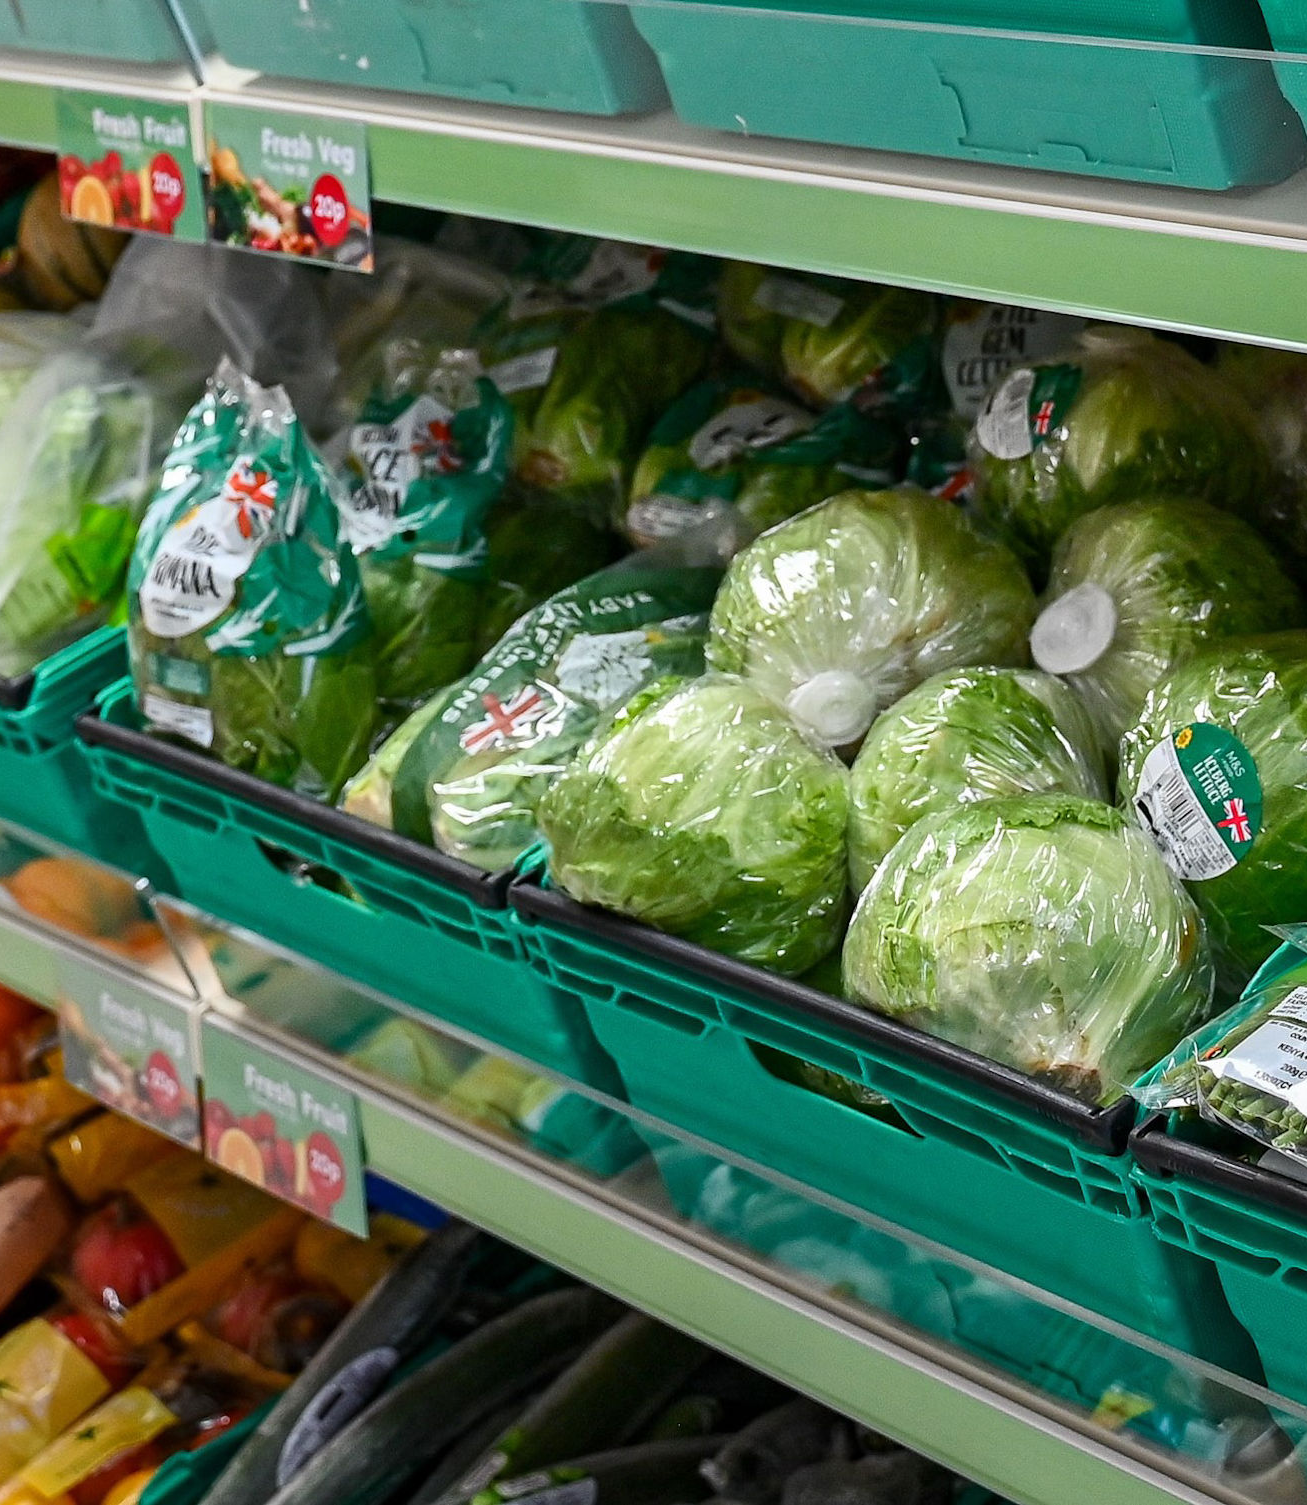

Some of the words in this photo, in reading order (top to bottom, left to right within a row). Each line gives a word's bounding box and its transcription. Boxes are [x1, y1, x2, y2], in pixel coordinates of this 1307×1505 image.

[93, 108, 140, 140] Fresh
[144, 116, 186, 147] Fruit
[261, 127, 312, 159] Fresh
[316, 136, 355, 174] Veg
[314, 194, 345, 223] 20p
[1193, 762, 1220, 805] LETTUCE
[1203, 755, 1233, 797] ICEBERG
[1226, 751, 1245, 777] M&S
[1278, 1043, 1305, 1059] KENYA
[1280, 1062, 1300, 1077] 200g
[243, 1063, 296, 1110] Fresh
[302, 1090, 348, 1135] Fruit
